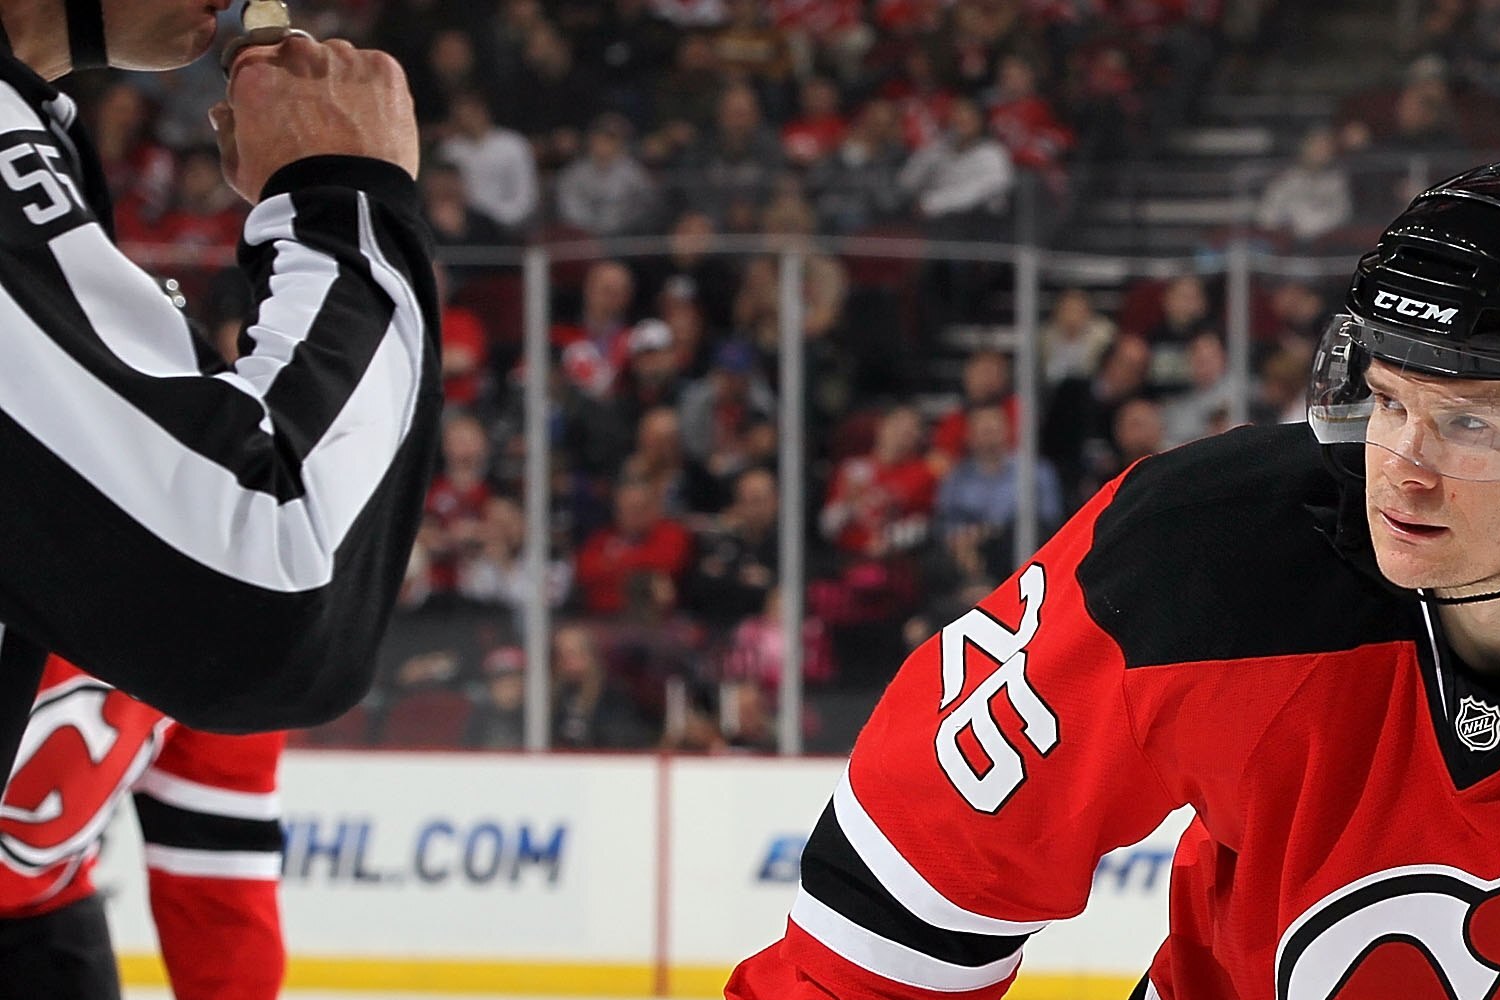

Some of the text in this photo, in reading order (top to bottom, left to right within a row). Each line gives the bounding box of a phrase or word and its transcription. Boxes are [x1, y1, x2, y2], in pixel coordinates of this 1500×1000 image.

[1373, 290, 1459, 324] CCM
[934, 562, 1062, 815] 26
[1463, 715, 1493, 736] NHL
[281, 819, 566, 884] HL.COM
